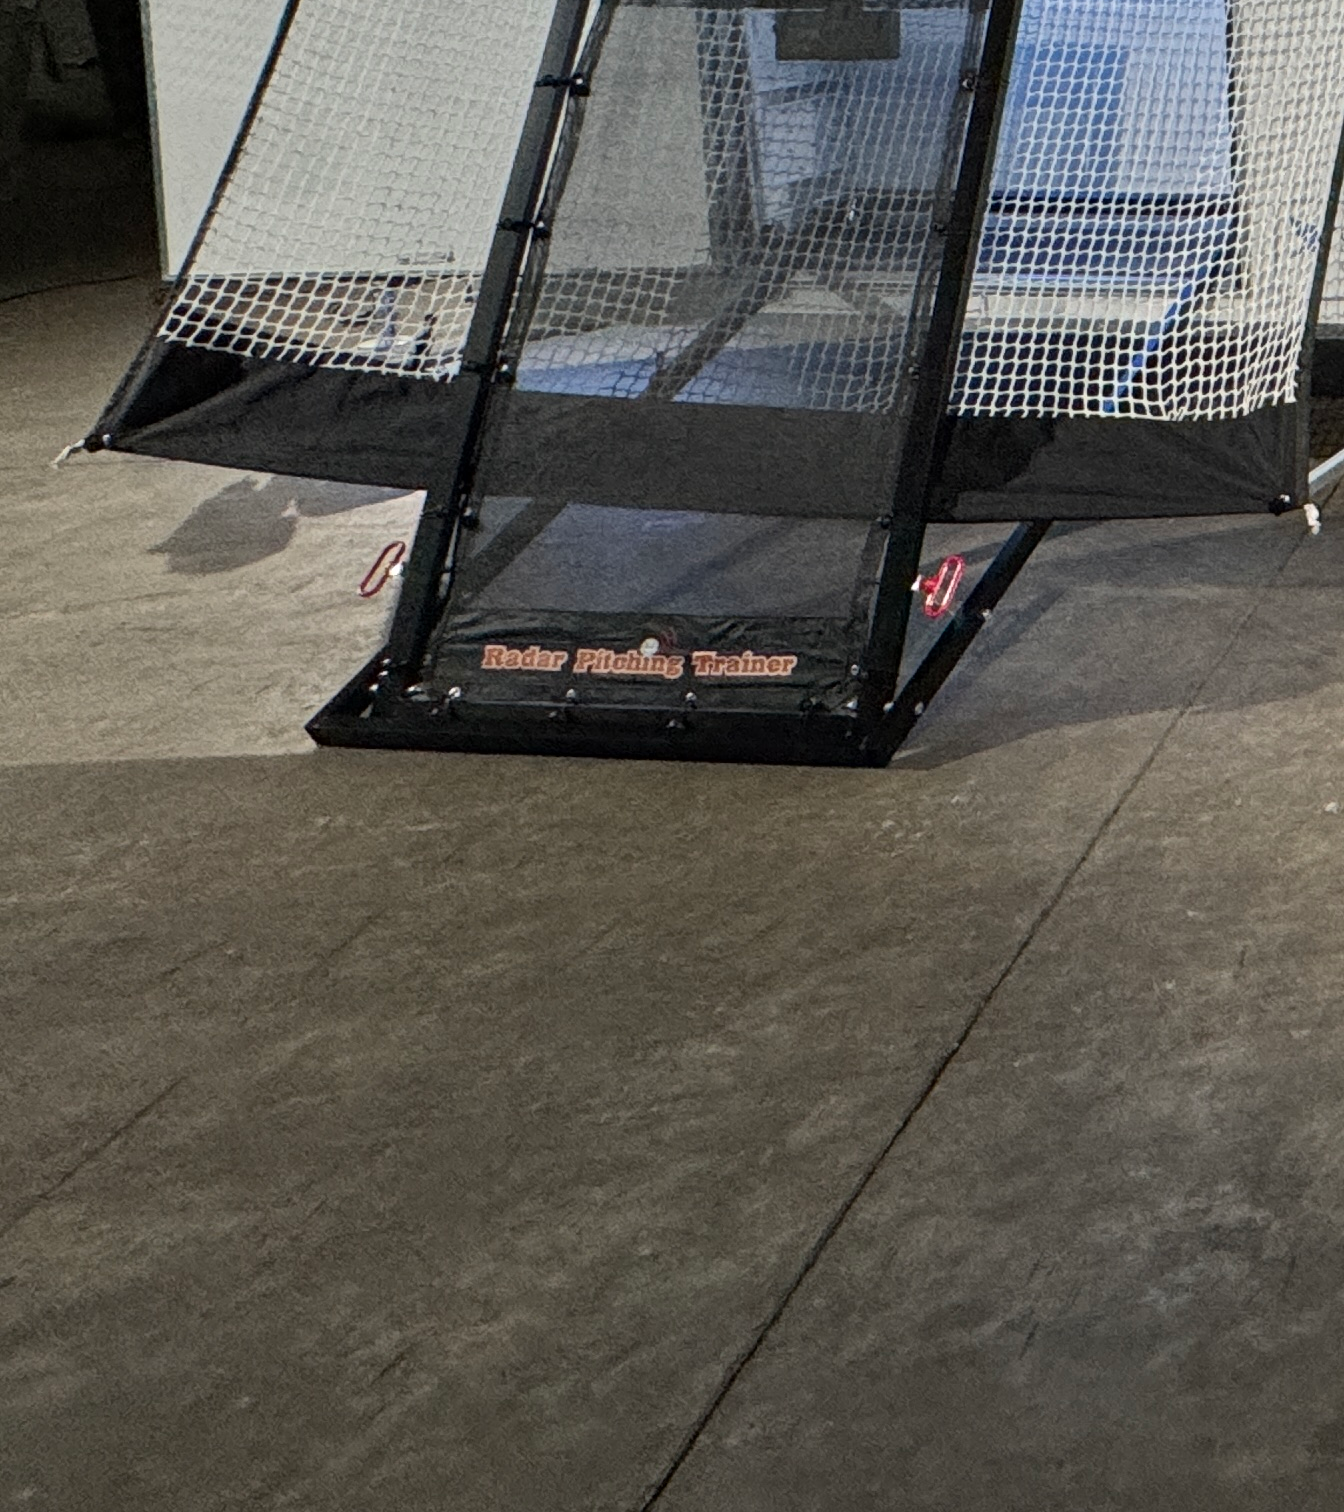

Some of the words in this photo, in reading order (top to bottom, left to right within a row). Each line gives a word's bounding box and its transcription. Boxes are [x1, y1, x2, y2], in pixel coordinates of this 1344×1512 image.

[482, 644, 568, 672] Radar
[573, 648, 684, 679] Pitching
[691, 649, 798, 676] Trainer
